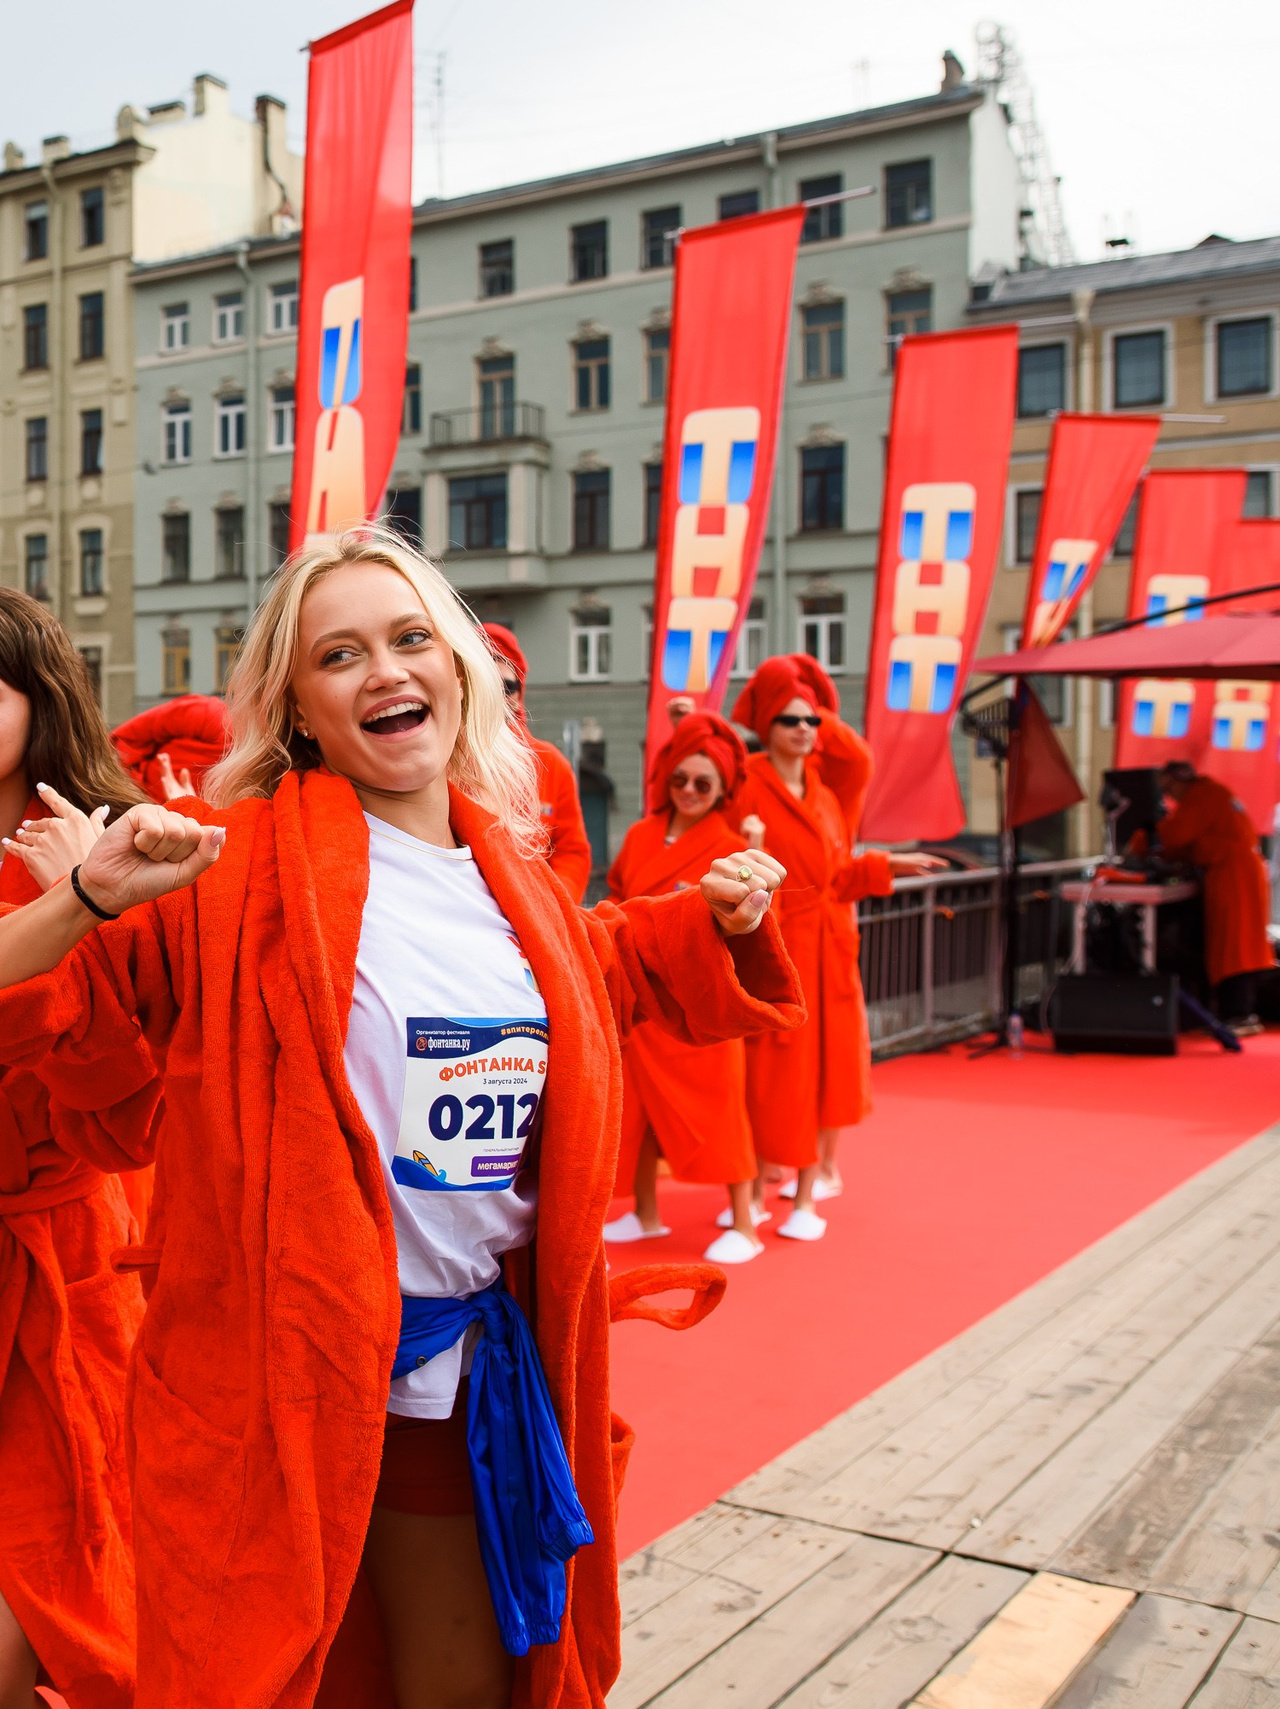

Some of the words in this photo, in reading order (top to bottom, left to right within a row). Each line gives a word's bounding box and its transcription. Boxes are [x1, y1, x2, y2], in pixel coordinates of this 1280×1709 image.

[662, 406, 760, 692] ТНТ
[885, 482, 977, 715] ТНТ
[416, 1029, 446, 1037] Организатор
[428, 1036, 471, 1051] фонтанка.ру
[439, 1057, 535, 1082] ФОНТАНКА
[428, 1093, 539, 1142] 0212
